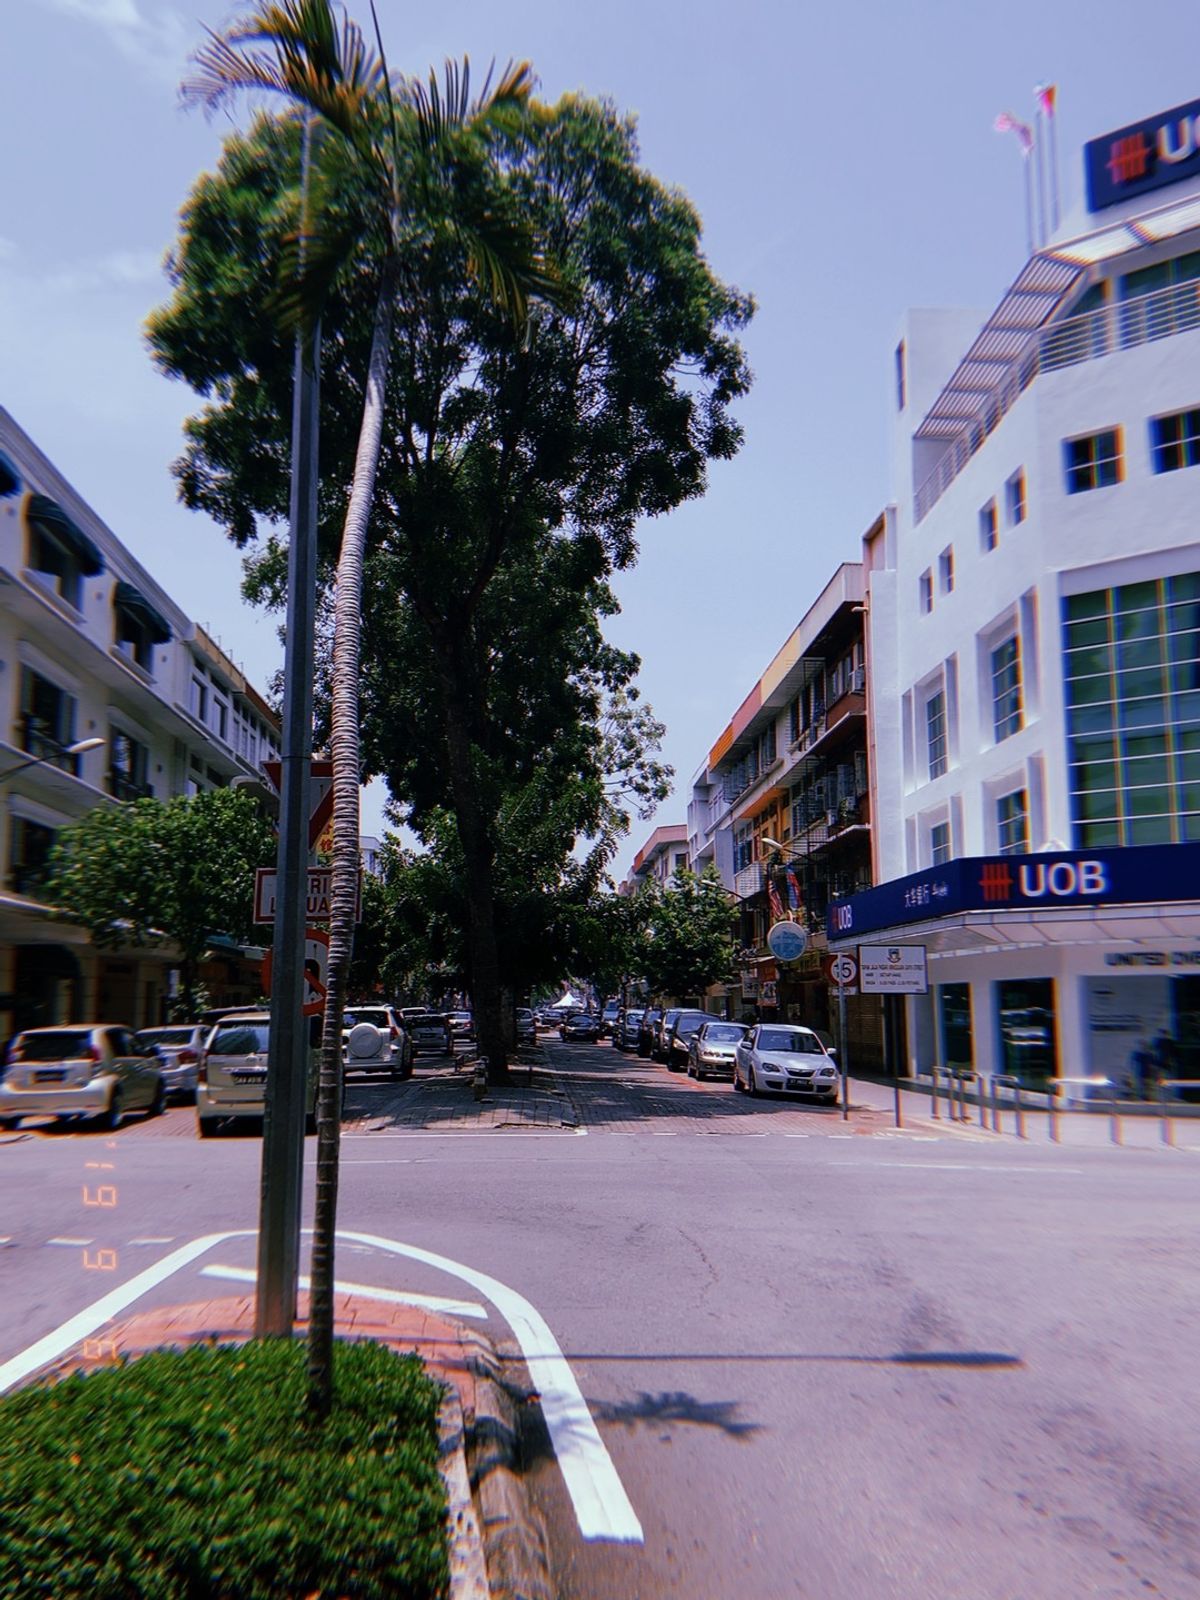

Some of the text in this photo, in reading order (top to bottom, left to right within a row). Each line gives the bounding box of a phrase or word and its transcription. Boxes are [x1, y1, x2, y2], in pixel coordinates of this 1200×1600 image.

[1157, 114, 1200, 164] U
[1019, 861, 1105, 897] UOB
[838, 904, 853, 930] UOB
